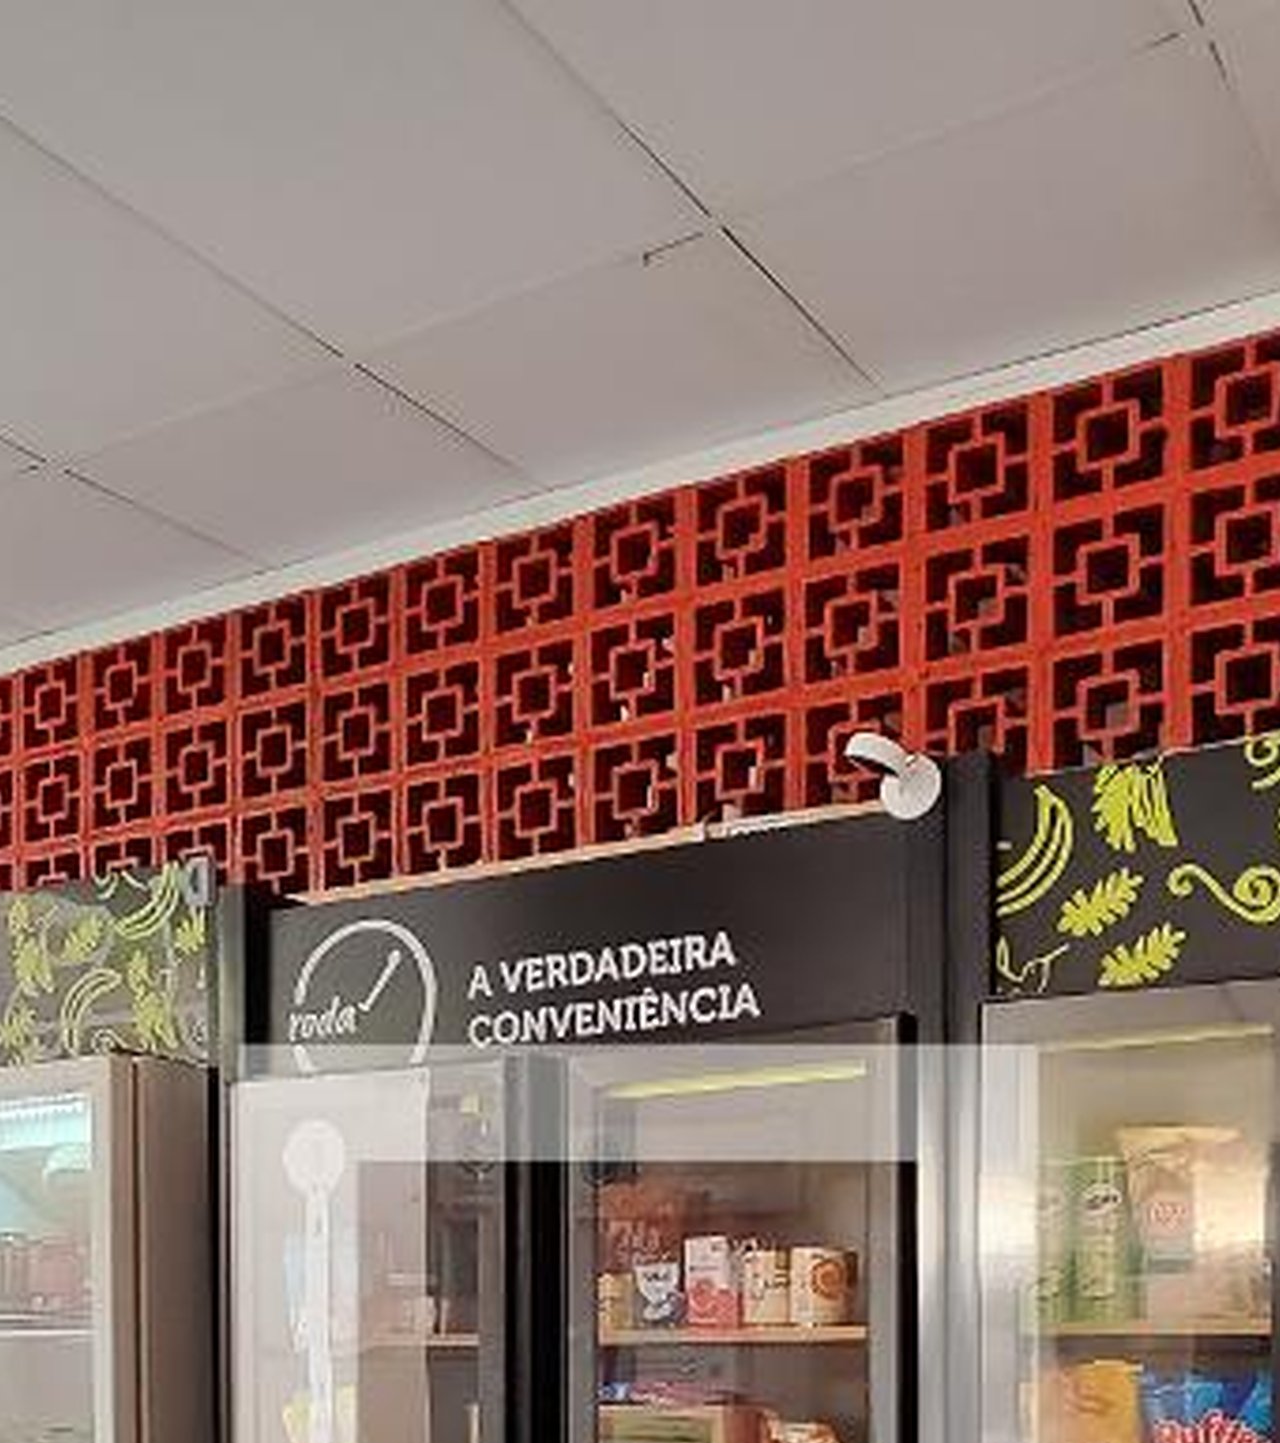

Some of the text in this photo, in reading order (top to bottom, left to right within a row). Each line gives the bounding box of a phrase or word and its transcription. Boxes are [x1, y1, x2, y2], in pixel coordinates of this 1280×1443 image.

[467, 931, 738, 1000] A VERDADEIRA
[288, 995, 357, 1041] roda
[468, 983, 762, 1049] CONVENIÊNCIA
